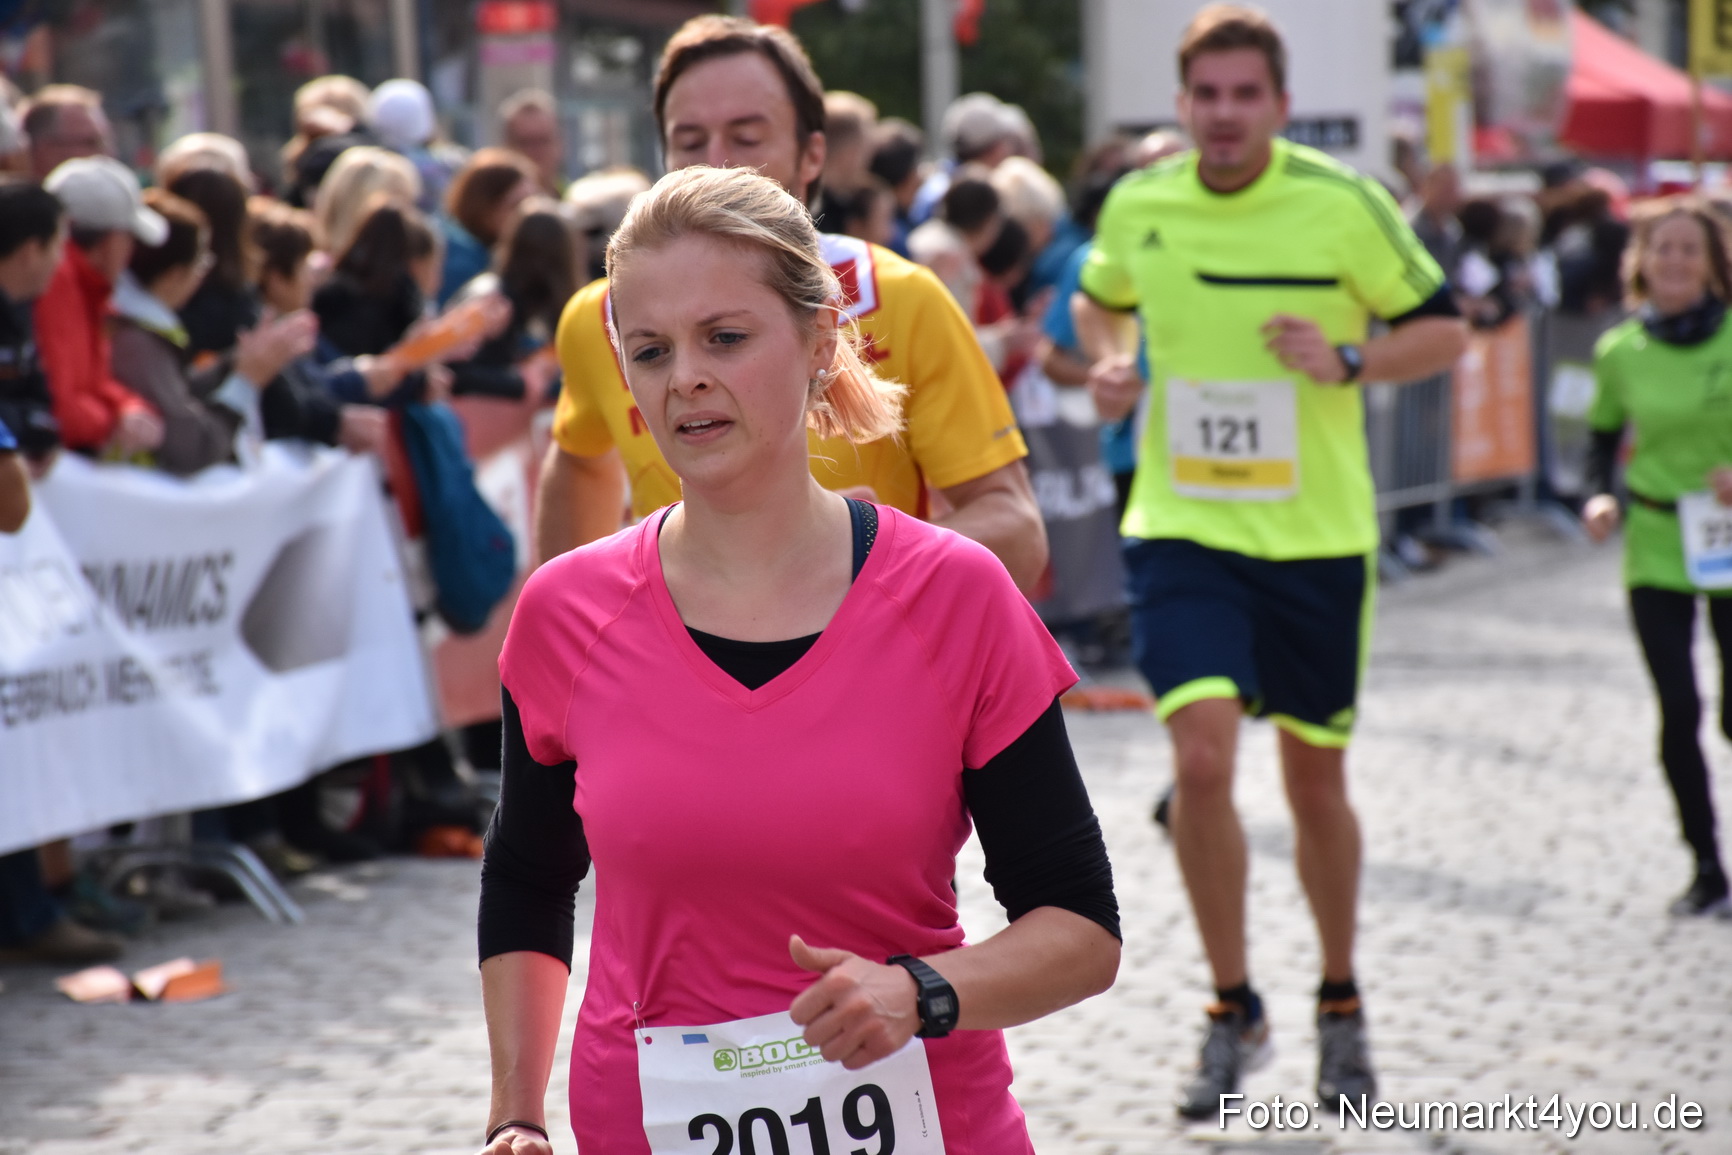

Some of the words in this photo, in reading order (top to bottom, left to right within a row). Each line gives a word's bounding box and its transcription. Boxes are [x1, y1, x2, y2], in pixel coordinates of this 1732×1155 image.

[1199, 416, 1260, 454] 121
[738, 1035, 822, 1070] BOC
[740, 1066, 771, 1078] inspired
[784, 1060, 807, 1071] smart
[688, 1084, 895, 1155] 2019
